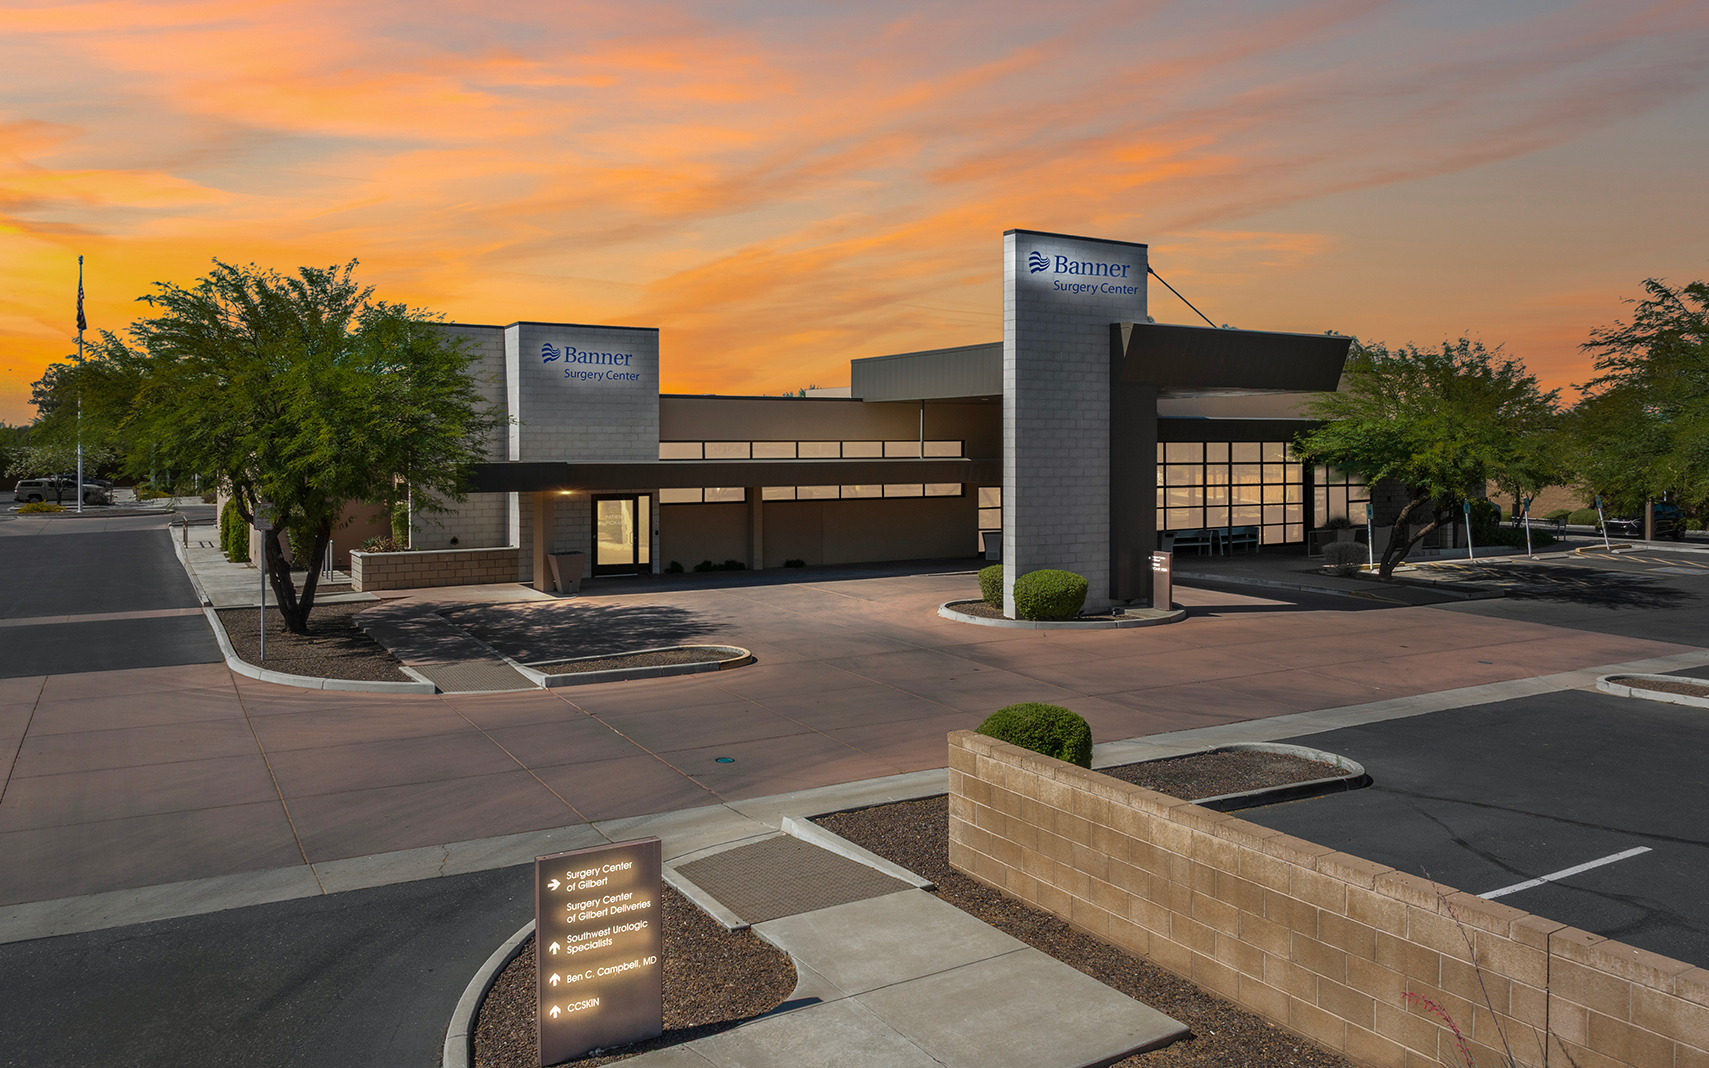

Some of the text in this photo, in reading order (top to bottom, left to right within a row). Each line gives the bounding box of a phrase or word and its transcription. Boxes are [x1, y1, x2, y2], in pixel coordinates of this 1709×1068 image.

[1053, 255, 1131, 278] Banner
[1053, 280, 1139, 295] Surgery Center
[563, 346, 633, 366] Banner
[564, 368, 640, 381] Surgery Center
[566, 861, 633, 880] Surgery Center
[566, 876, 608, 892] of Gilbert
[566, 892, 633, 912] Surgery Center
[566, 900, 651, 924] of Gilbert Deliveries
[566, 920, 648, 944] Southwest Urologic
[566, 937, 613, 955] Specialists
[566, 955, 657, 984] Ben C. Campbell, MD
[567, 997, 600, 1013] CCSKIN
